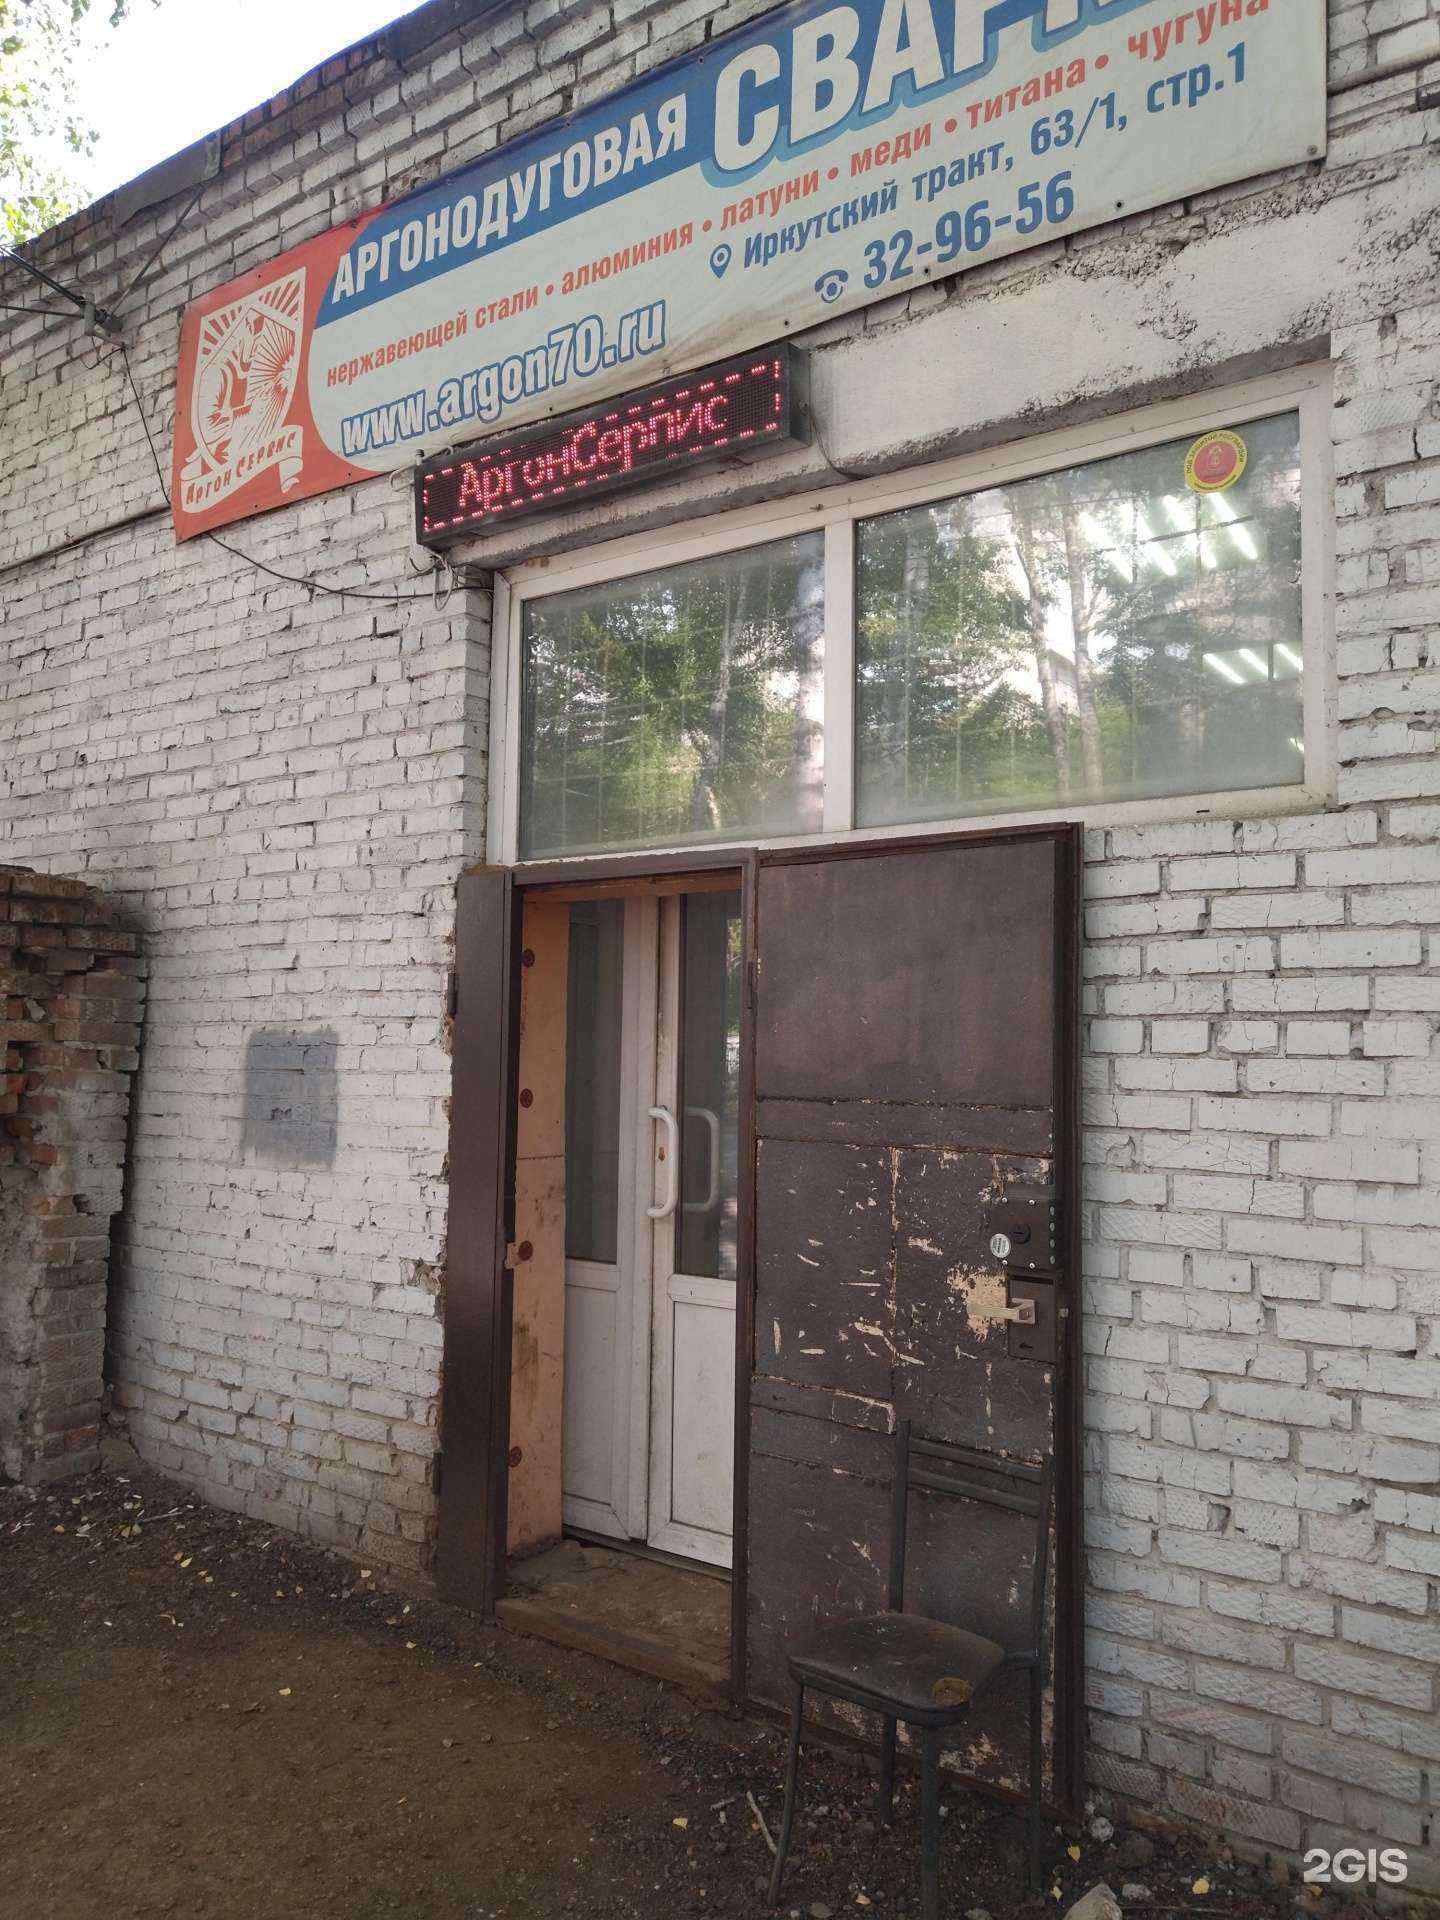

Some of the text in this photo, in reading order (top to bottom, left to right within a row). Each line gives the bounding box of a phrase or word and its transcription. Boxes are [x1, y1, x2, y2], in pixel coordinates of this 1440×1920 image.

[326, 311, 468, 388] нержавеющей
[475, 285, 539, 329] стали
[561, 219, 694, 295] алюминия
[720, 168, 820, 231] латуни
[850, 122, 932, 177] меди
[965, 57, 1086, 130] титана
[332, 93, 687, 304] АРГОНОДУГОВАЯ
[743, 178, 898, 268] Иркутский
[911, 141, 1014, 202] тракт,
[1030, 91, 1128, 156] 63/1,
[863, 170, 1075, 290] 32-96-56
[340, 299, 667, 458] www.argon70.ru
